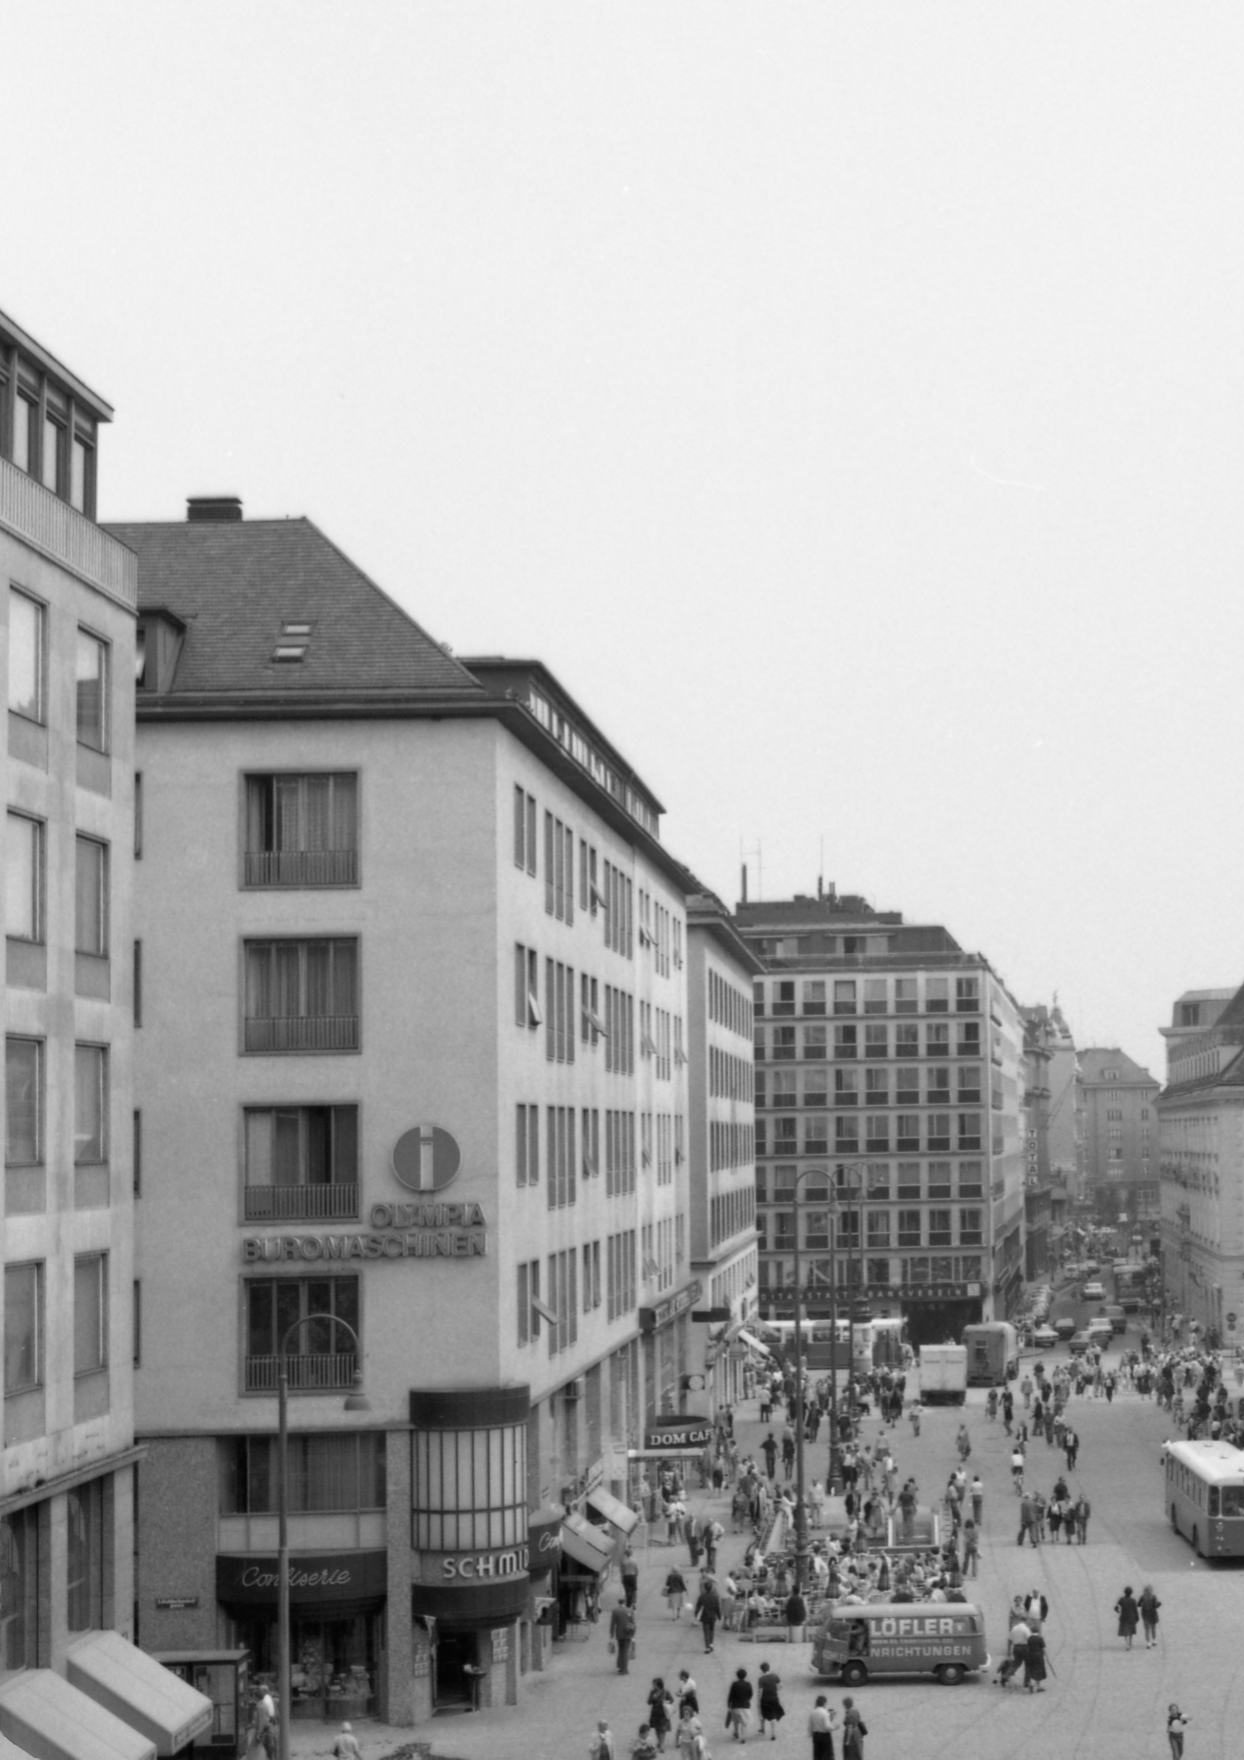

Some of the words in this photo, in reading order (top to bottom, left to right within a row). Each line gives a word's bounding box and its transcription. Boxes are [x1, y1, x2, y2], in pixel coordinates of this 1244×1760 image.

[1028, 1129, 1037, 1185] TOTAL
[370, 1203, 487, 1228] OLYMPIA
[651, 1433, 686, 1446] DOM
[241, 1566, 351, 1588] Coniserie
[870, 1617, 953, 1636] LÖFLER
[870, 1645, 972, 1658] NRICHTUNGEN
